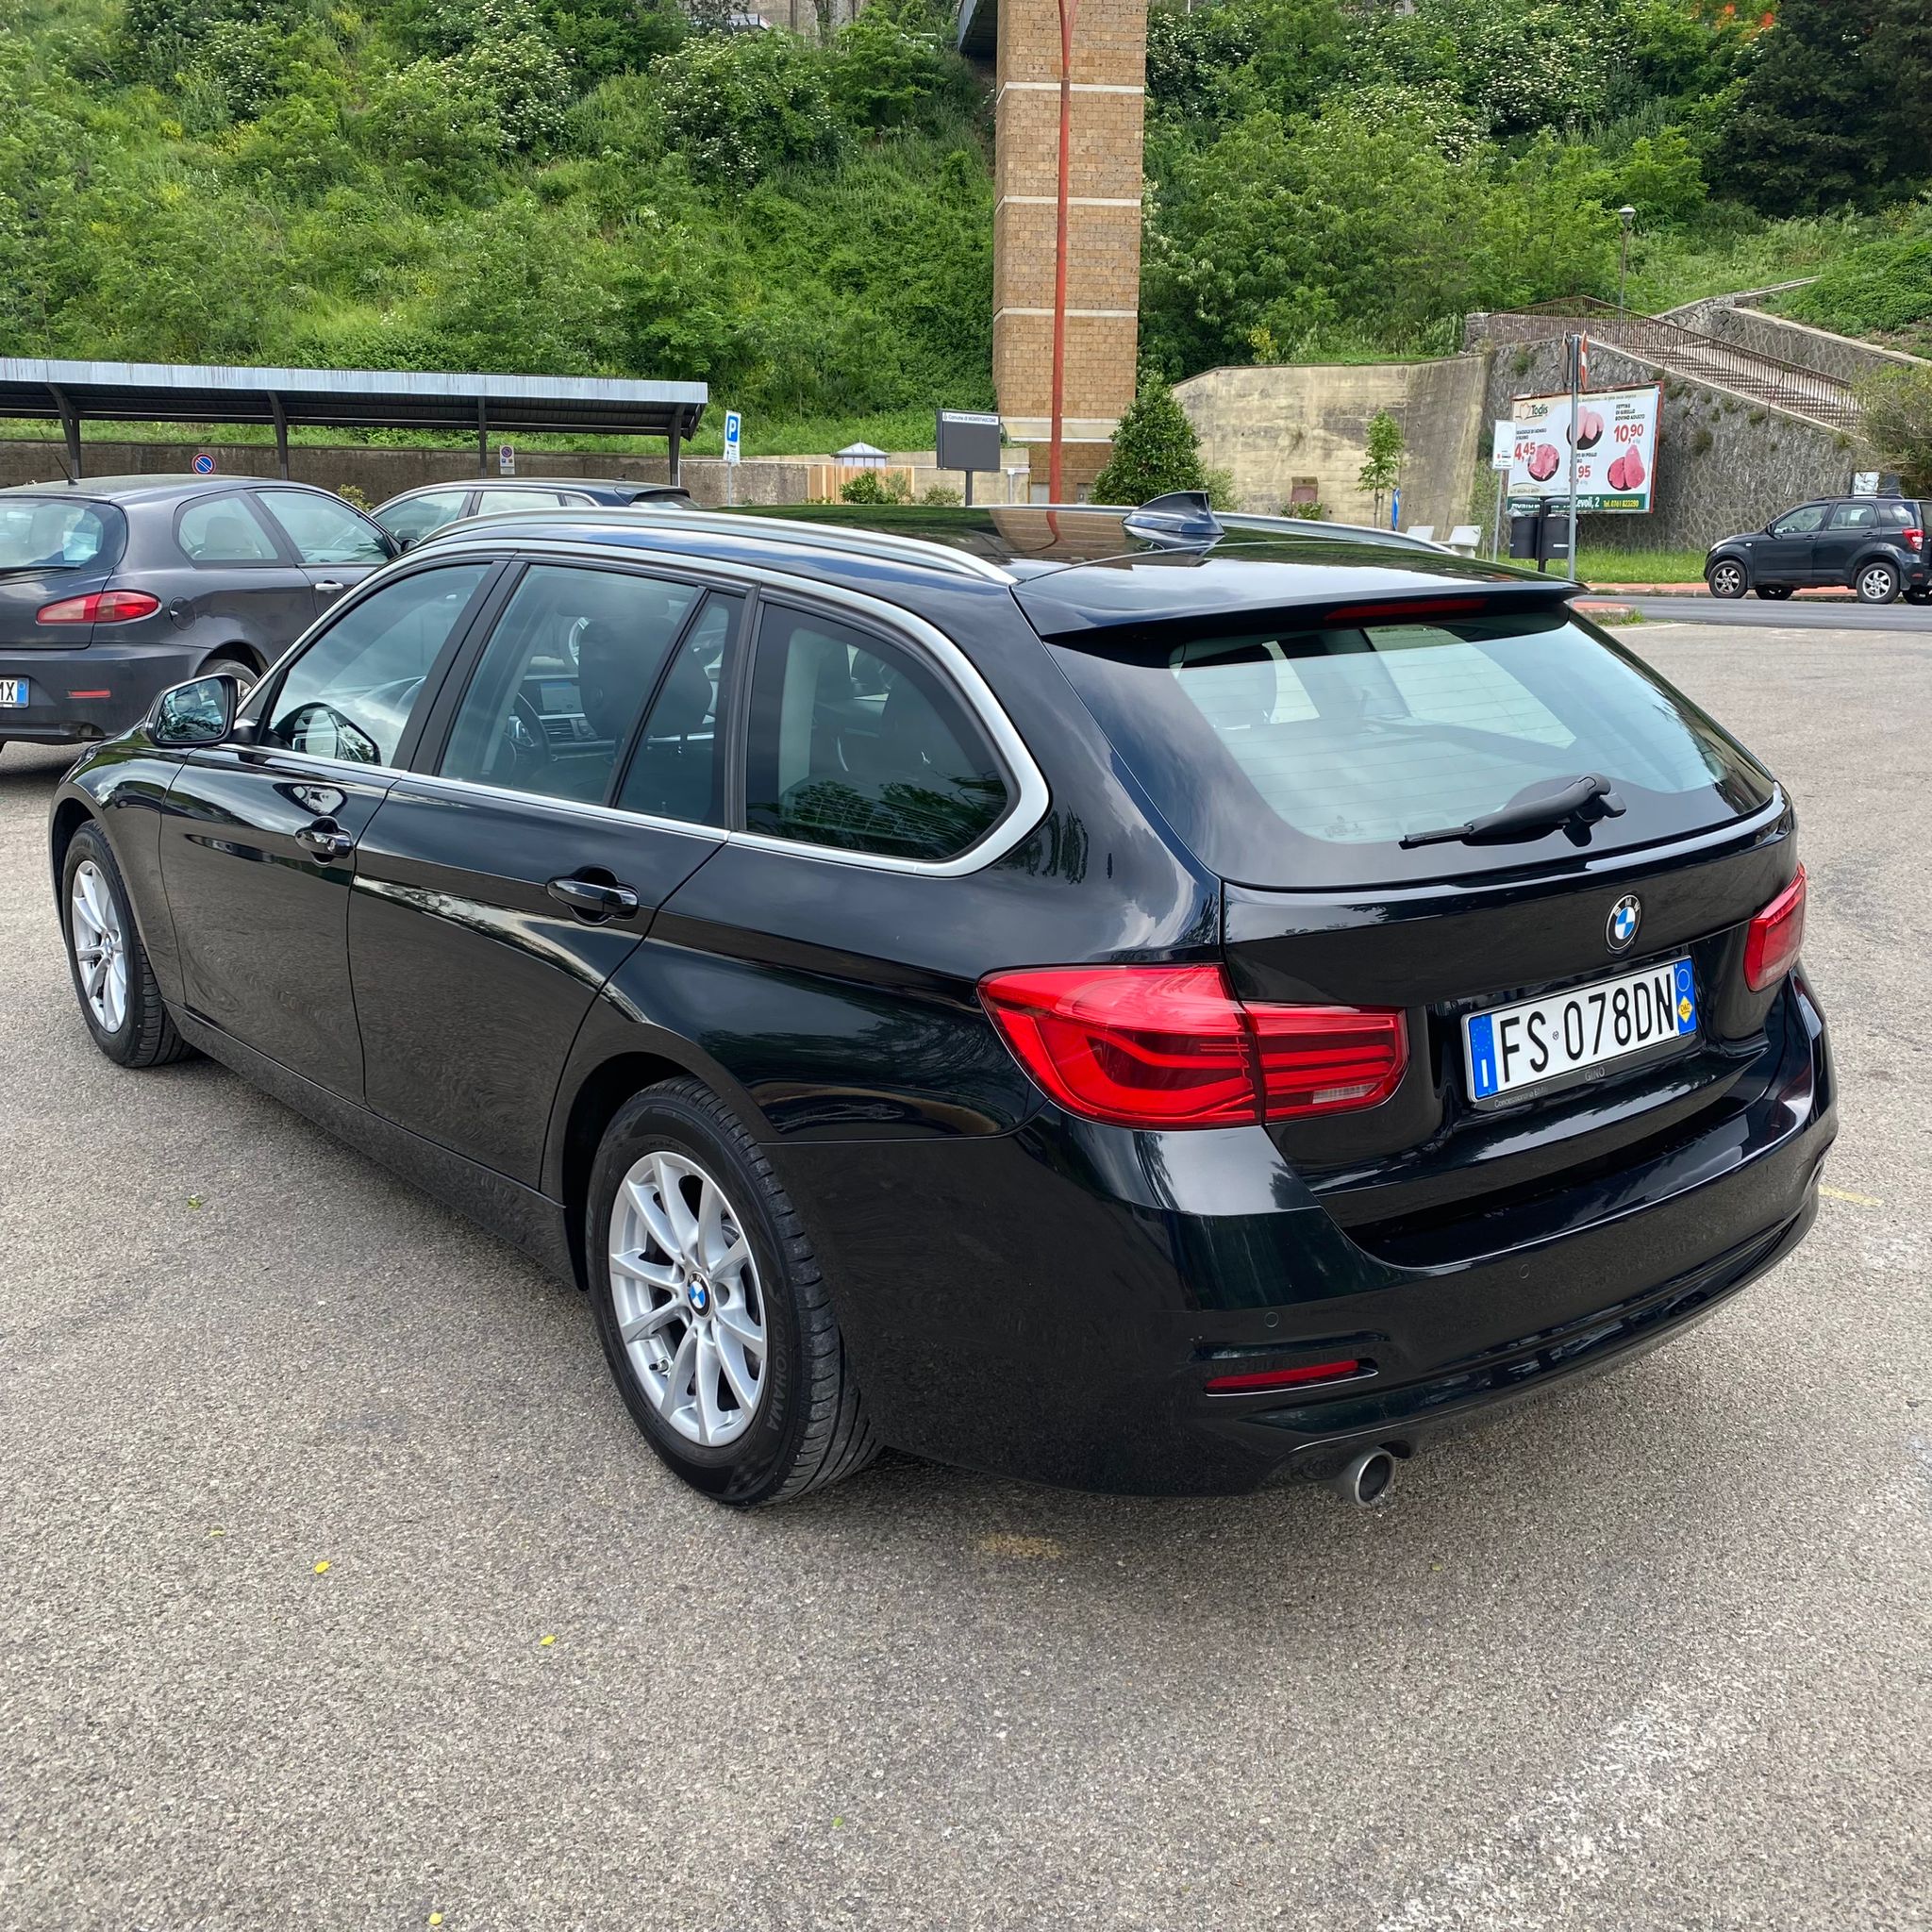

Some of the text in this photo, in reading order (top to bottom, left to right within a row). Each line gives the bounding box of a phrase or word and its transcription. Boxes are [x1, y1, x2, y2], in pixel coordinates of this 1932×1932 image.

[1531, 404, 1548, 415] Todis
[728, 419, 737, 439] P
[1614, 424, 1644, 443] 10,90
[1514, 441, 1536, 461] 4,45
[1575, 496, 1594, 508] evoli,
[1594, 497, 1600, 508] 2
[1500, 973, 1674, 1084] FS 078DN
[1481, 1058, 1489, 1088] I
[1585, 1067, 1606, 1081] GINO
[766, 1313, 788, 1431] YOKOHAMA
